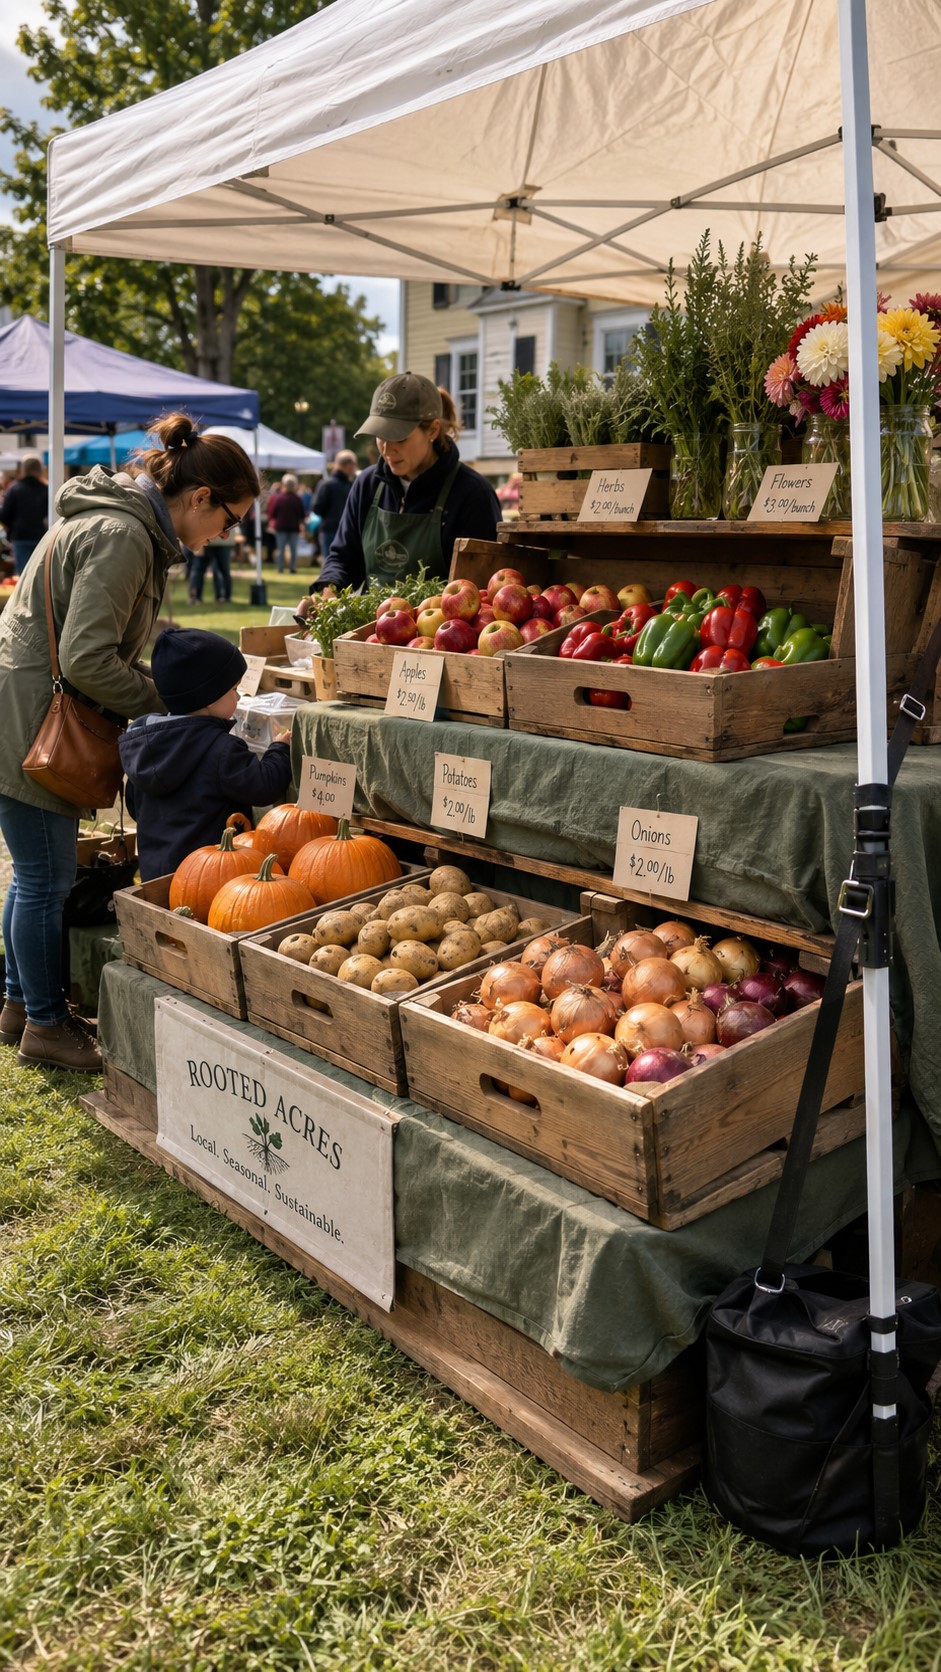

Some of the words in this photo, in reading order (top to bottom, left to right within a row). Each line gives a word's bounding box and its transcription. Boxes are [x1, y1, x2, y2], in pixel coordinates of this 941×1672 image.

[596, 477, 625, 493] Herbs
[770, 472, 813, 490] Flowers
[763, 497, 816, 515] $3.00/bunch
[399, 660, 427, 683] Apples
[397, 688, 426, 712] $2.50/lb
[309, 764, 347, 787] Pumpkins
[442, 763, 478, 789] Potatoes
[312, 787, 336, 806] $4.00
[442, 795, 476, 824] $2.00/lb
[631, 819, 671, 845] Onions
[629, 853, 675, 884] $2.00/lb
[187, 1059, 268, 1108] ROOTED
[274, 1095, 344, 1170] ACRES
[190, 1124, 220, 1159] Local.
[223, 1148, 271, 1194] Seasonal.
[275, 1184, 345, 1244] Sustainable.
